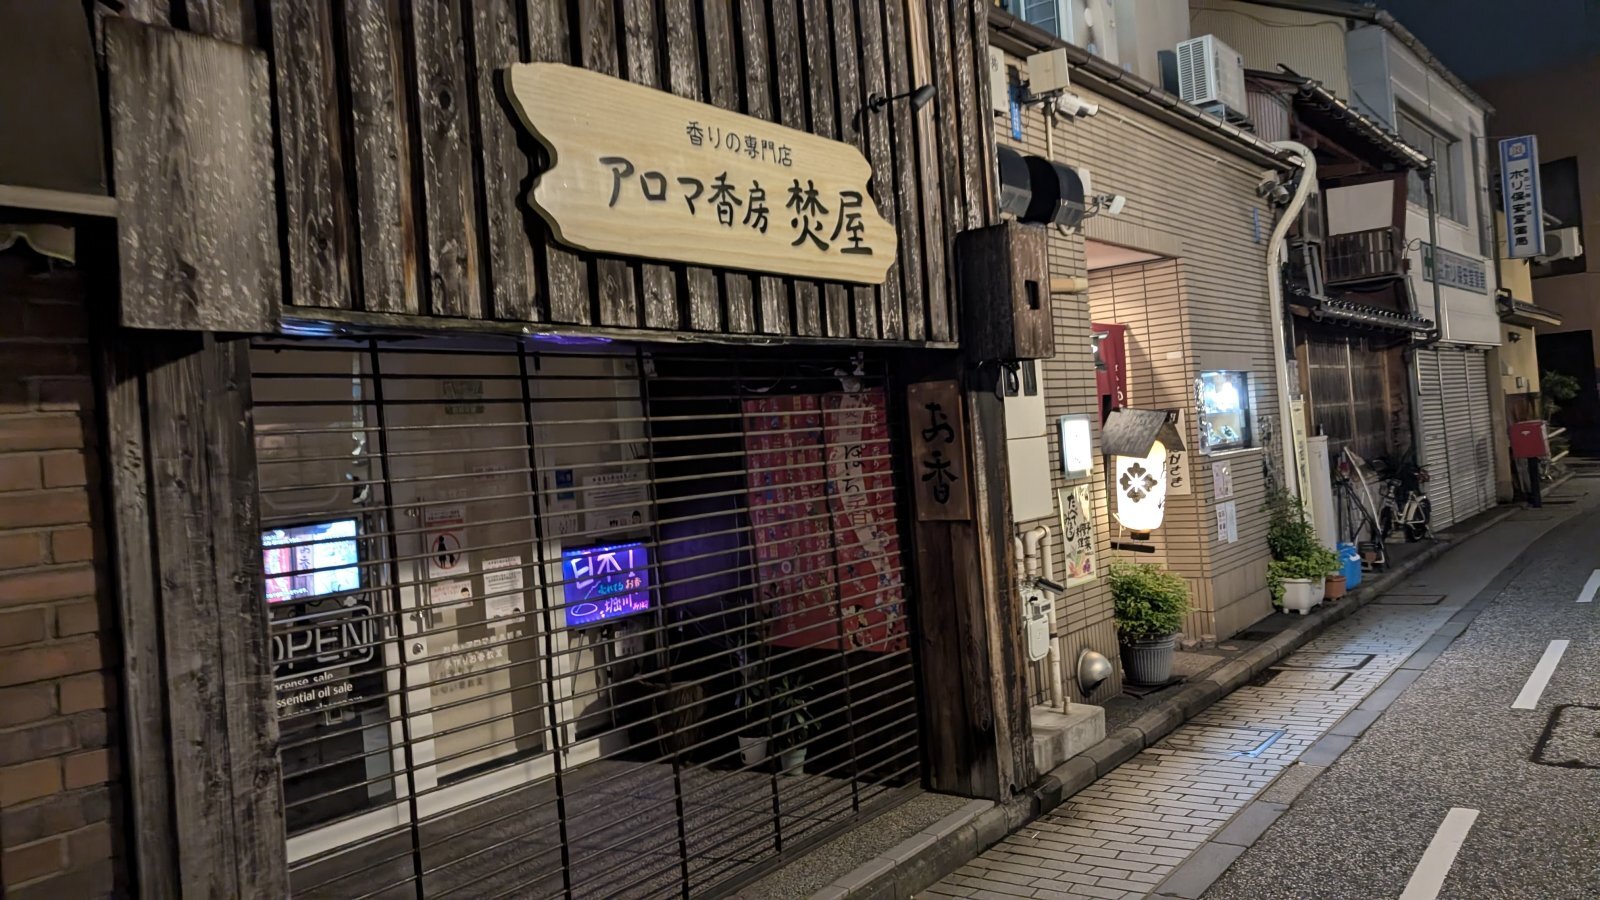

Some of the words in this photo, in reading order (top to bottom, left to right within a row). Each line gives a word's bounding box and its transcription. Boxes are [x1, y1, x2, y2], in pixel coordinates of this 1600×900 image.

[686, 121, 793, 167] 香りの専門店
[599, 155, 770, 234] アロマ香房
[786, 178, 873, 255] 焚屋
[922, 403, 959, 505] お香
[275, 689, 316, 709] ssential
[318, 686, 331, 699] oil
[333, 682, 354, 695] sale
